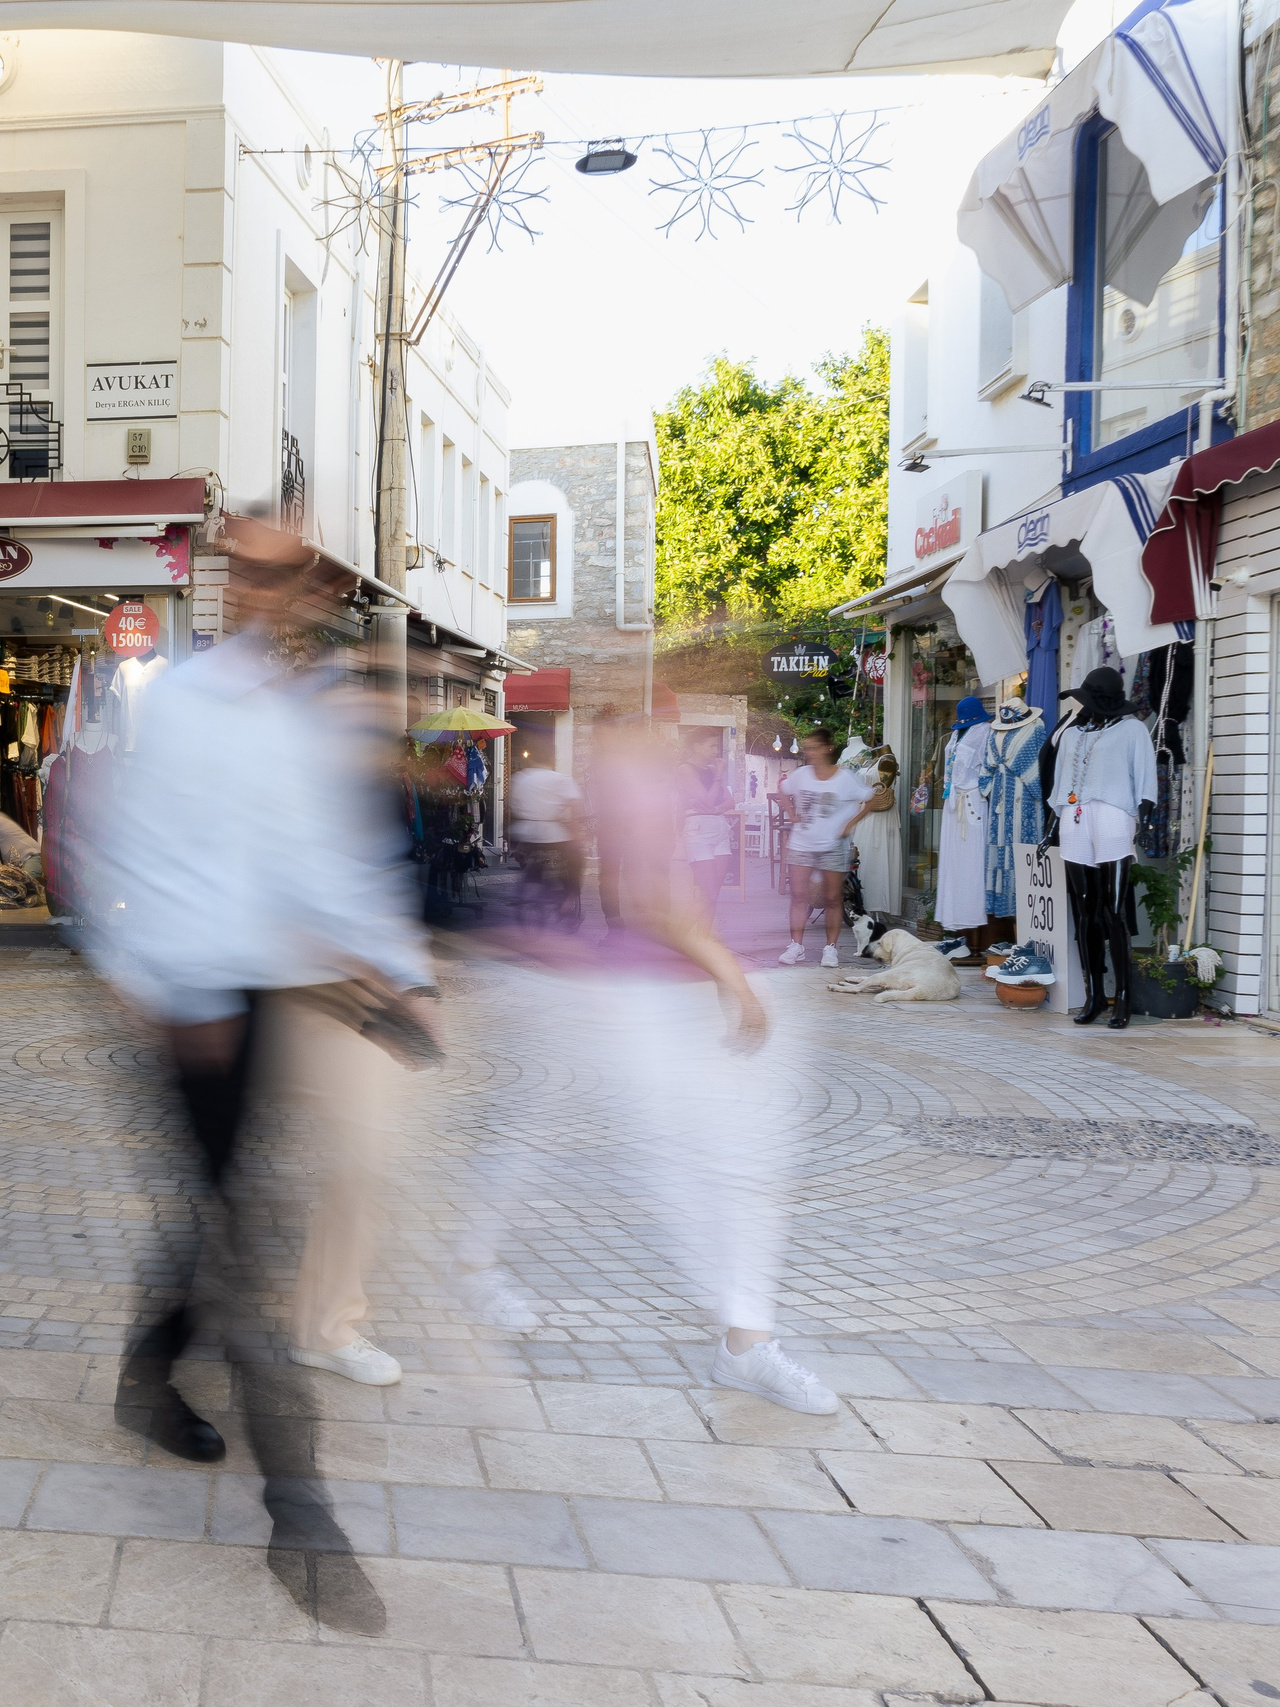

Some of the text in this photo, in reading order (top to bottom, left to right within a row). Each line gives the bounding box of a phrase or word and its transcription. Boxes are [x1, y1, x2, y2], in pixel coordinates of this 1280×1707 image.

[91, 374, 174, 392] AVUKAT
[95, 398, 170, 410] Derya ERGAN KILIÇ
[132, 433, 143, 441] 57
[132, 444, 146, 453] C10
[118, 616, 146, 631] 40€
[770, 656, 830, 672] TAKILIN
[800, 662, 828, 678] Pub
[1026, 853, 1052, 888] %50
[1028, 894, 1054, 932] %30
